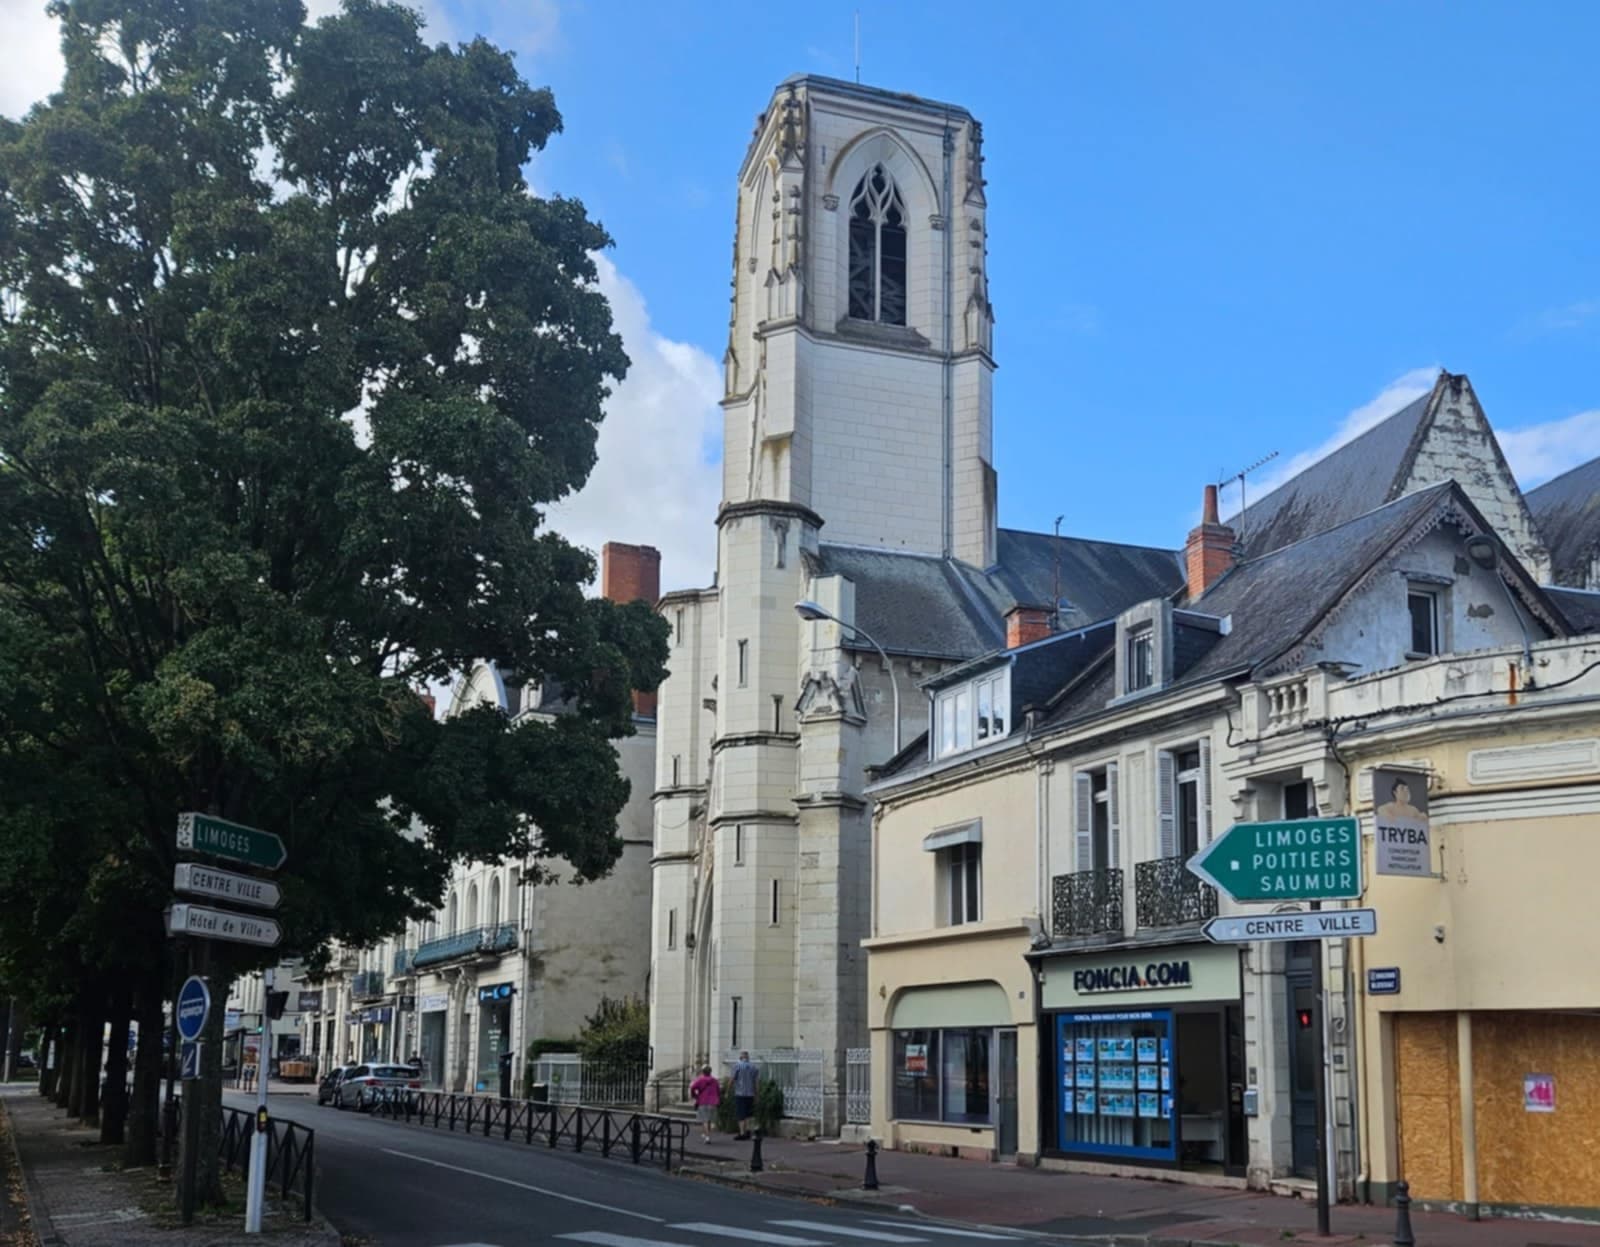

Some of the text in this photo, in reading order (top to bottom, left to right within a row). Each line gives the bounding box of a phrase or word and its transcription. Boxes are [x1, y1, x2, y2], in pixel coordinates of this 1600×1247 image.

[197, 824, 250, 853] LIMOGES
[1255, 826, 1351, 848] LIMOGES
[1378, 826, 1428, 845] TRYBA
[1252, 849, 1351, 870] POITIERS
[192, 872, 262, 899] CENTRE VILLE
[1260, 872, 1352, 892] SAUMUR
[189, 912, 262, 937] Hôtel de Ville
[1246, 916, 1361, 935] CENTRE VILLE
[1073, 961, 1191, 991] FONCIA.COM
